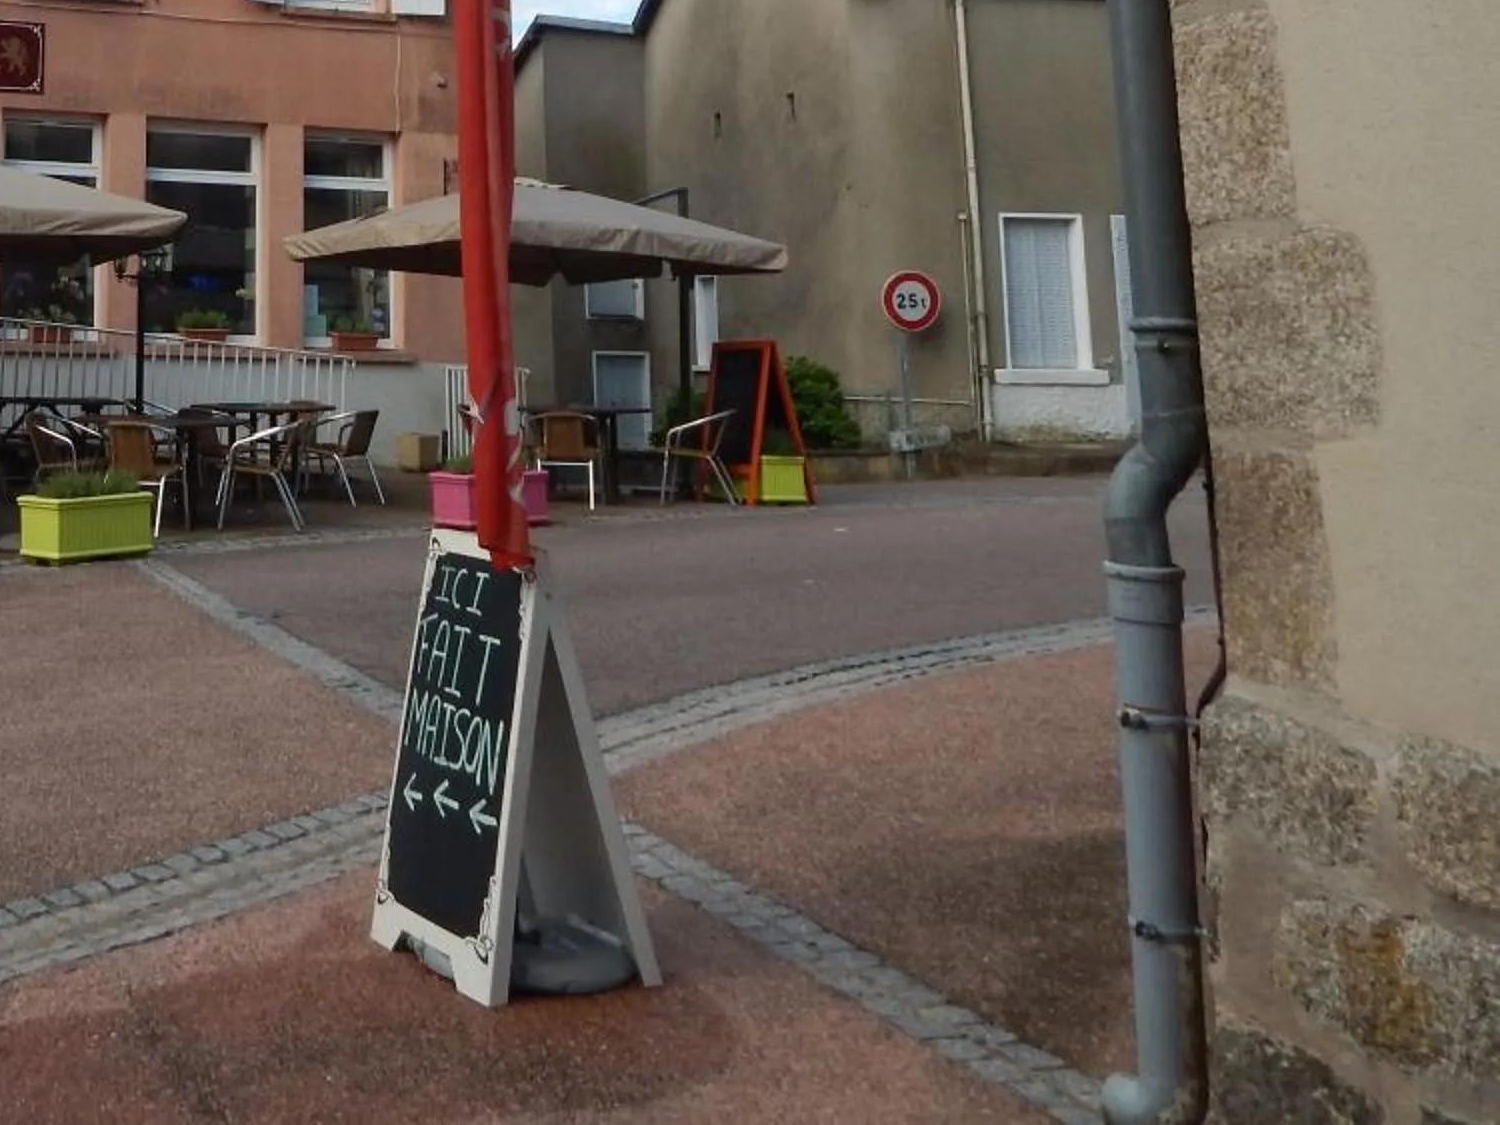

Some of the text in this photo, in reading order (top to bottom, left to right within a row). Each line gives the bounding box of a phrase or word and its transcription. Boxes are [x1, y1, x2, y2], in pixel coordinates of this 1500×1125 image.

[434, 565, 490, 616] ICI
[416, 612, 501, 707] FAIT
[404, 686, 504, 795] MAISON
